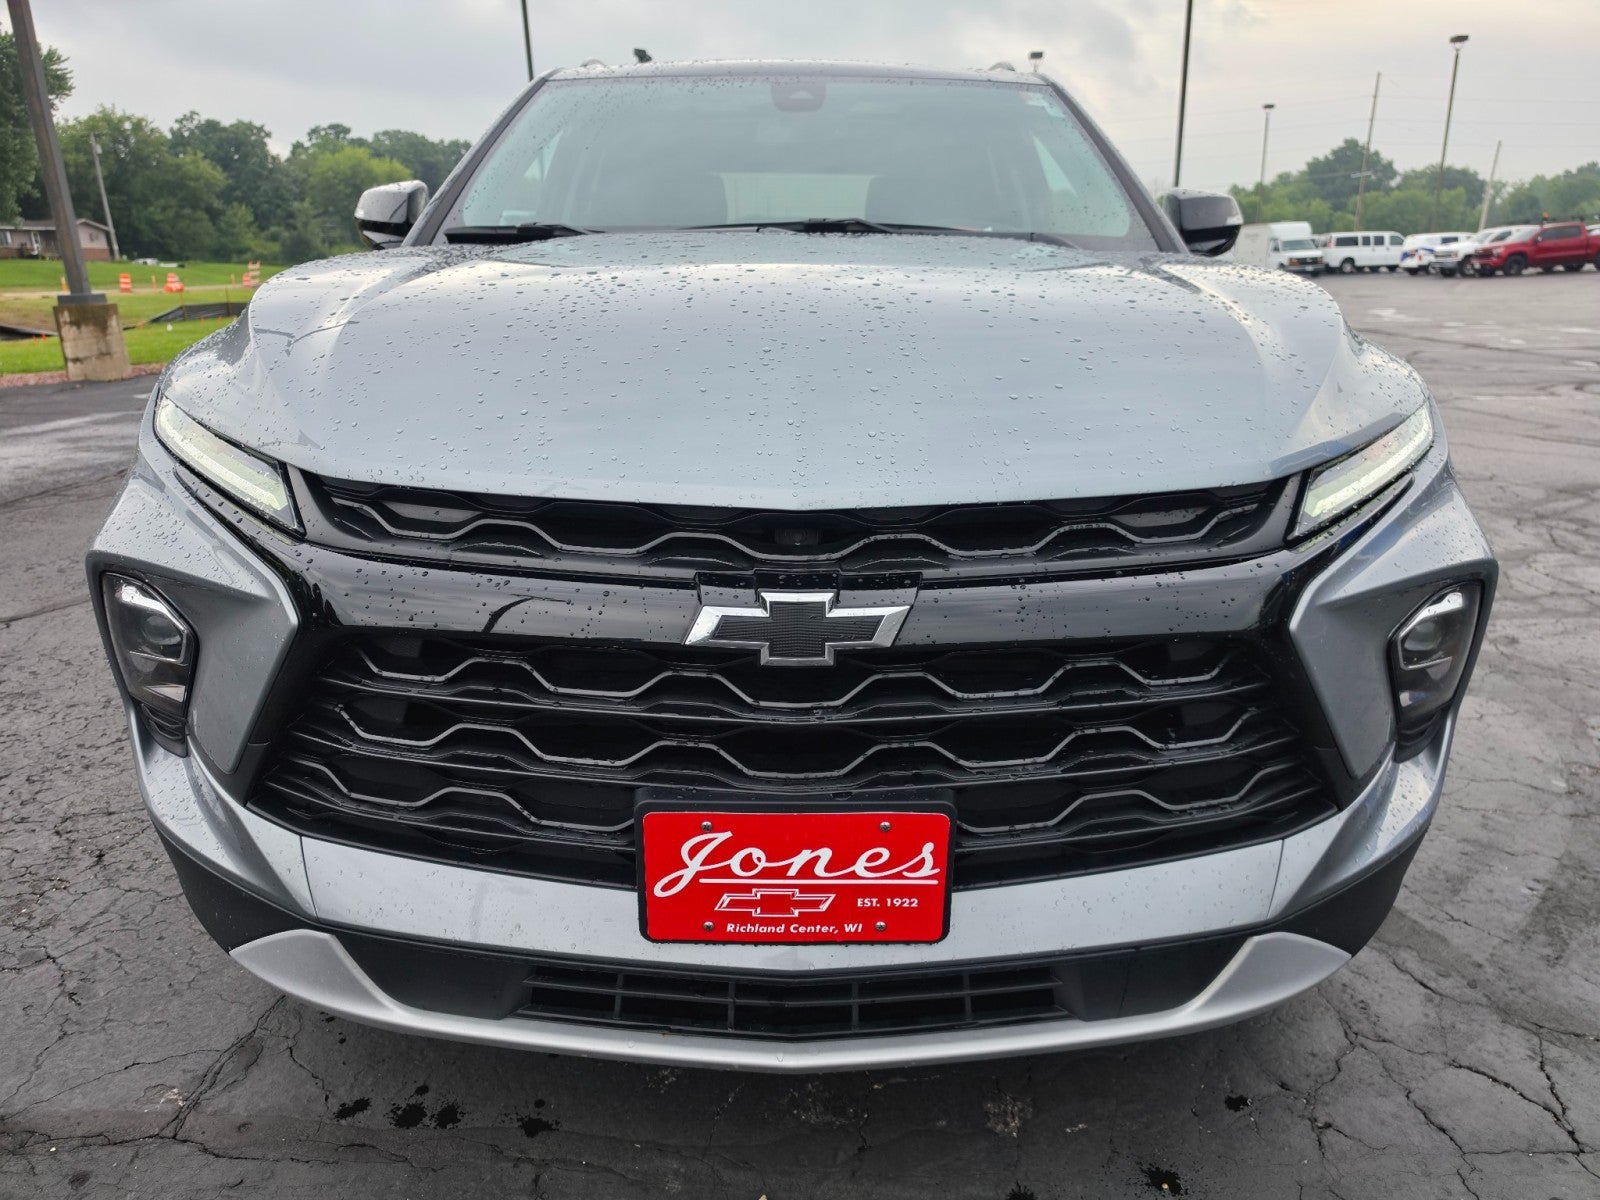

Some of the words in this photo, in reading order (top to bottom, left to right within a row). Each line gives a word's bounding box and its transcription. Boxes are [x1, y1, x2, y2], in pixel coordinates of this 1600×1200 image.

[653, 831, 941, 898] Jones
[857, 898, 881, 908] EST.
[886, 898, 919, 908] 1922
[726, 923, 787, 934] Richland
[790, 923, 839, 935] Center,
[844, 923, 864, 934] WI
